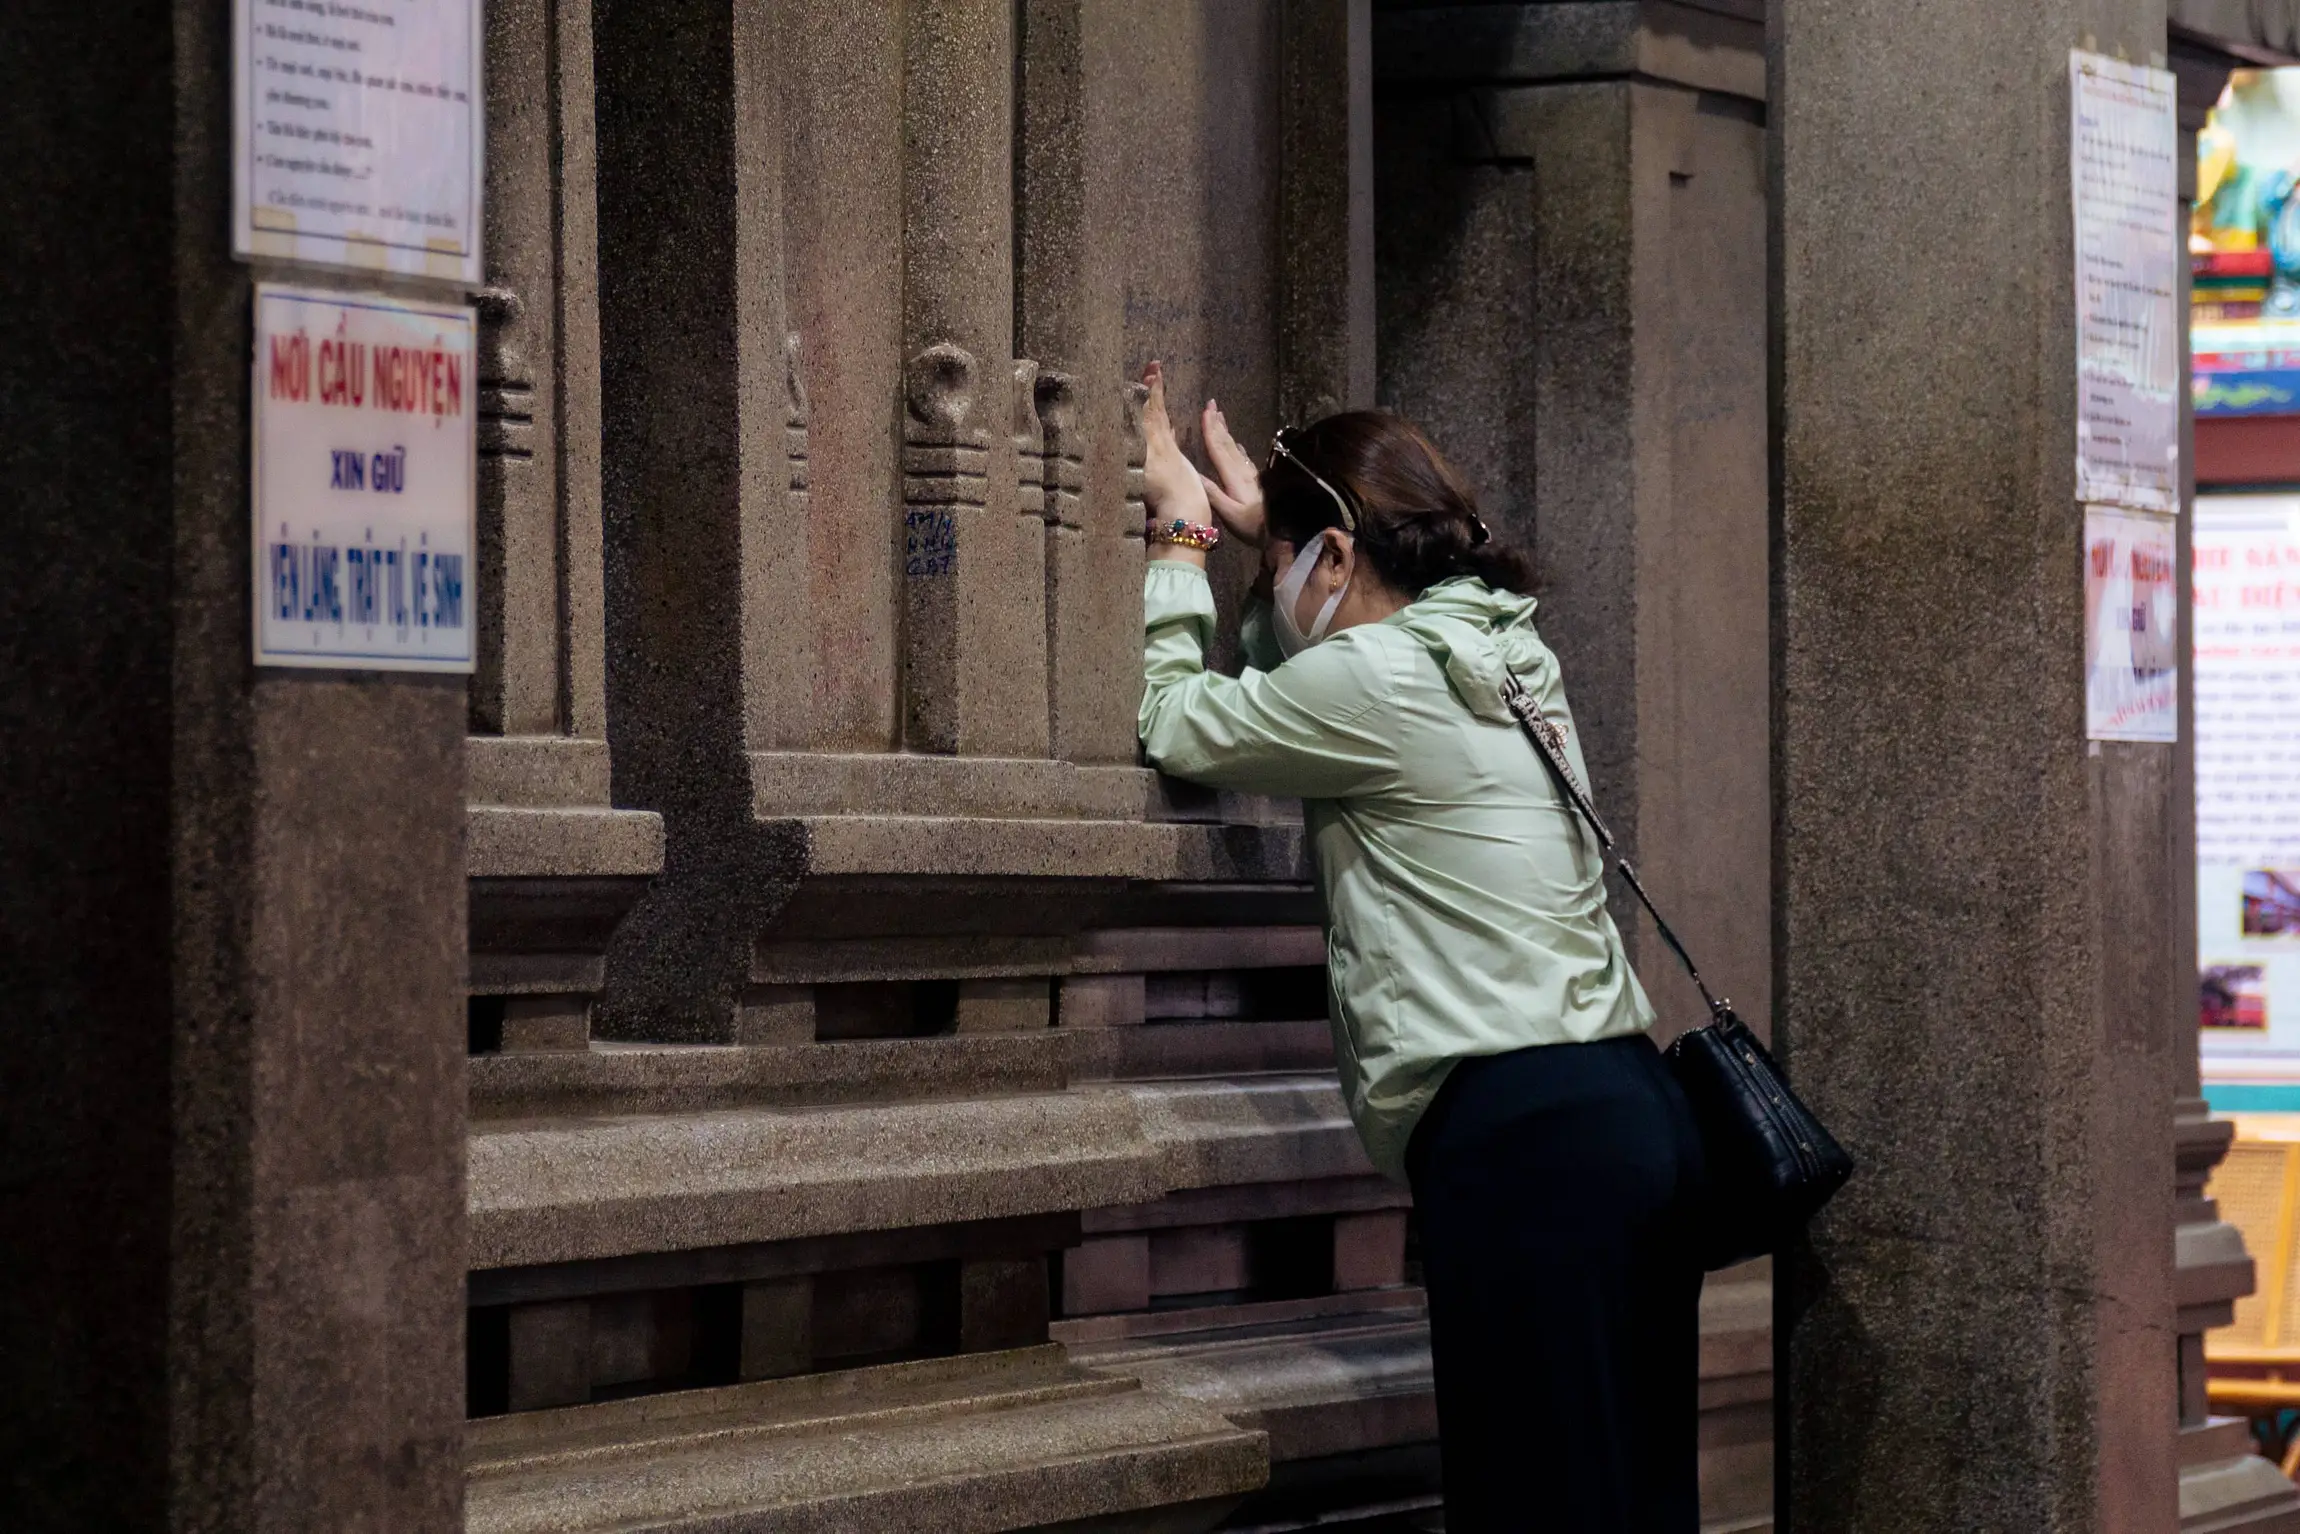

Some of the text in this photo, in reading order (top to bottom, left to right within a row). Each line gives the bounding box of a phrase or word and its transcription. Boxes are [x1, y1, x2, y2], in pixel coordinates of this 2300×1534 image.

[271, 327, 309, 403] NƠI
[372, 333, 461, 429] NGUYỆN
[331, 444, 406, 494] XIN GIỮ
